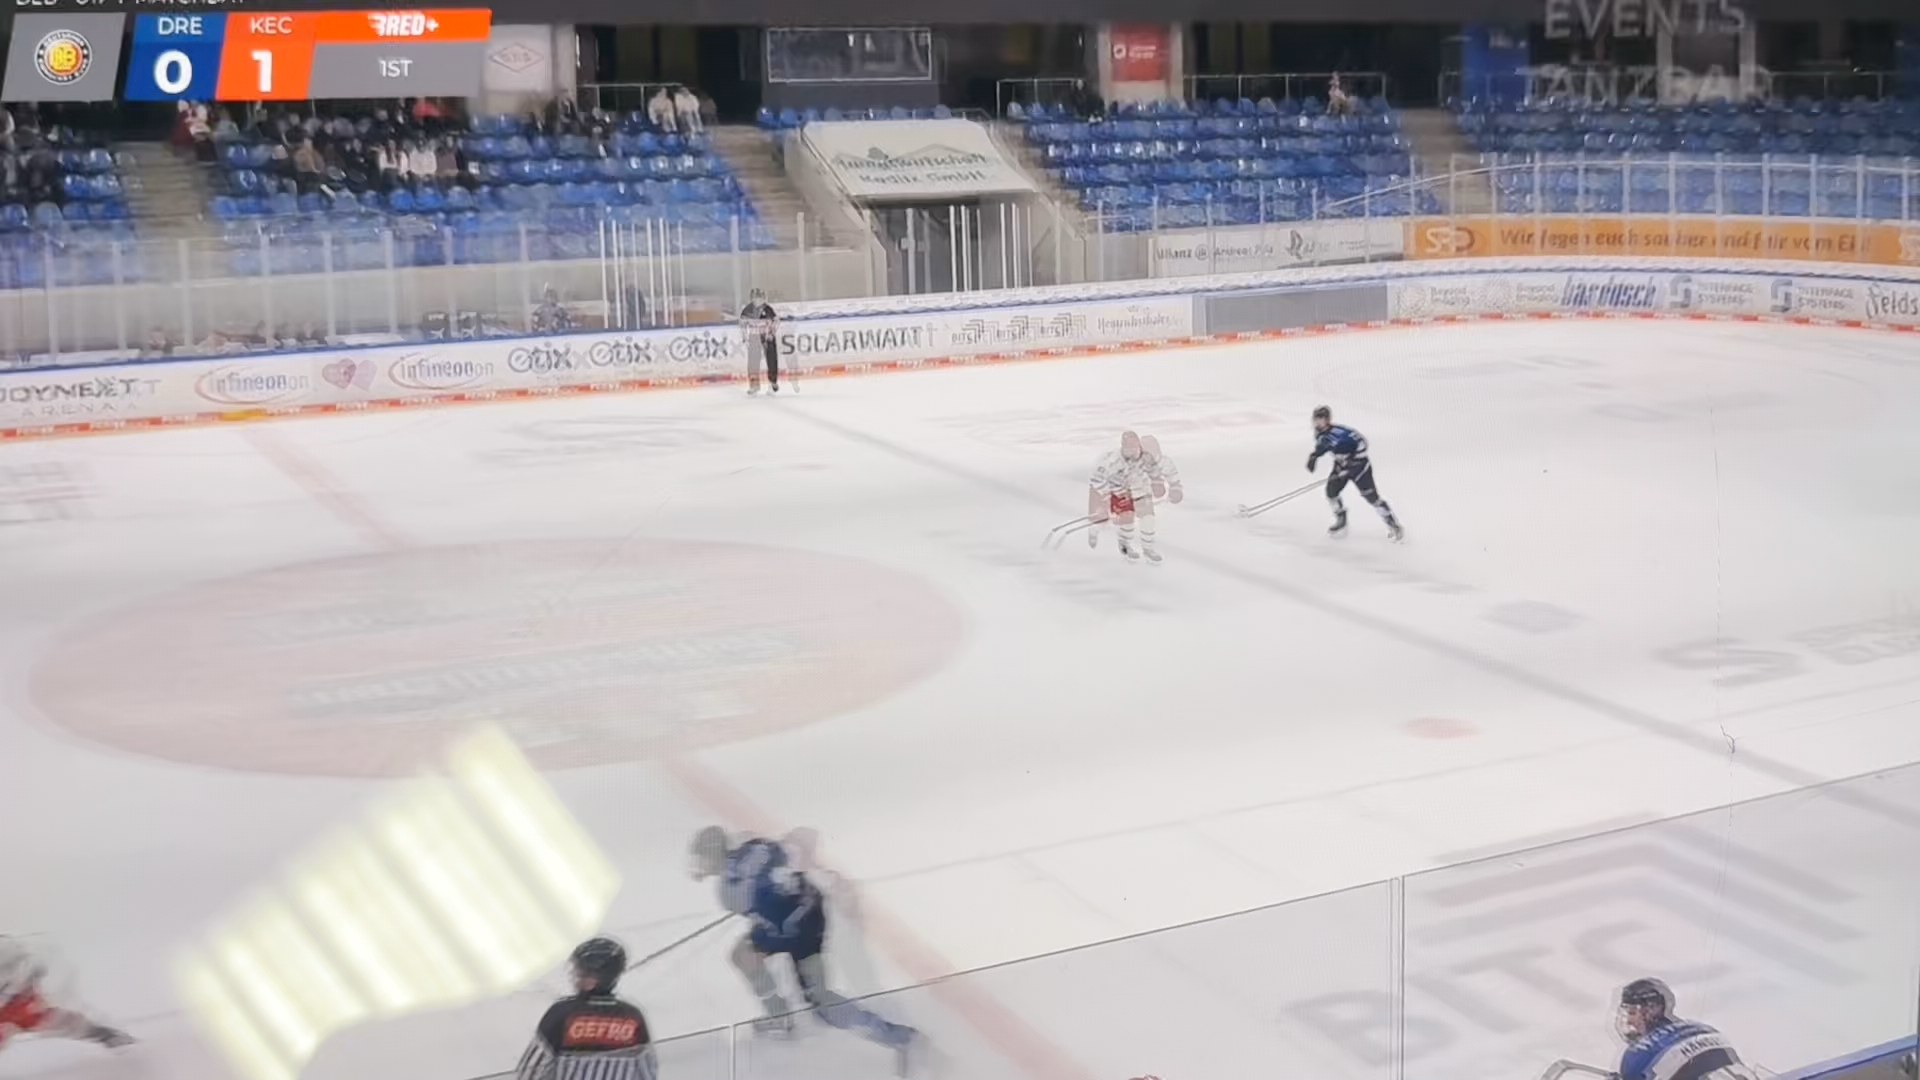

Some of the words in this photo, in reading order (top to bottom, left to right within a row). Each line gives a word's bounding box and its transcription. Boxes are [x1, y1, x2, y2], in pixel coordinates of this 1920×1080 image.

[158, 16, 203, 34] DRE
[250, 18, 293, 35] KEC
[154, 50, 192, 94] 0
[251, 50, 273, 93] 1
[378, 57, 413, 77] 1ST
[1501, 229, 1535, 245] Wir
[1595, 229, 1639, 246] euch
[780, 322, 937, 355] SOLARWATT
